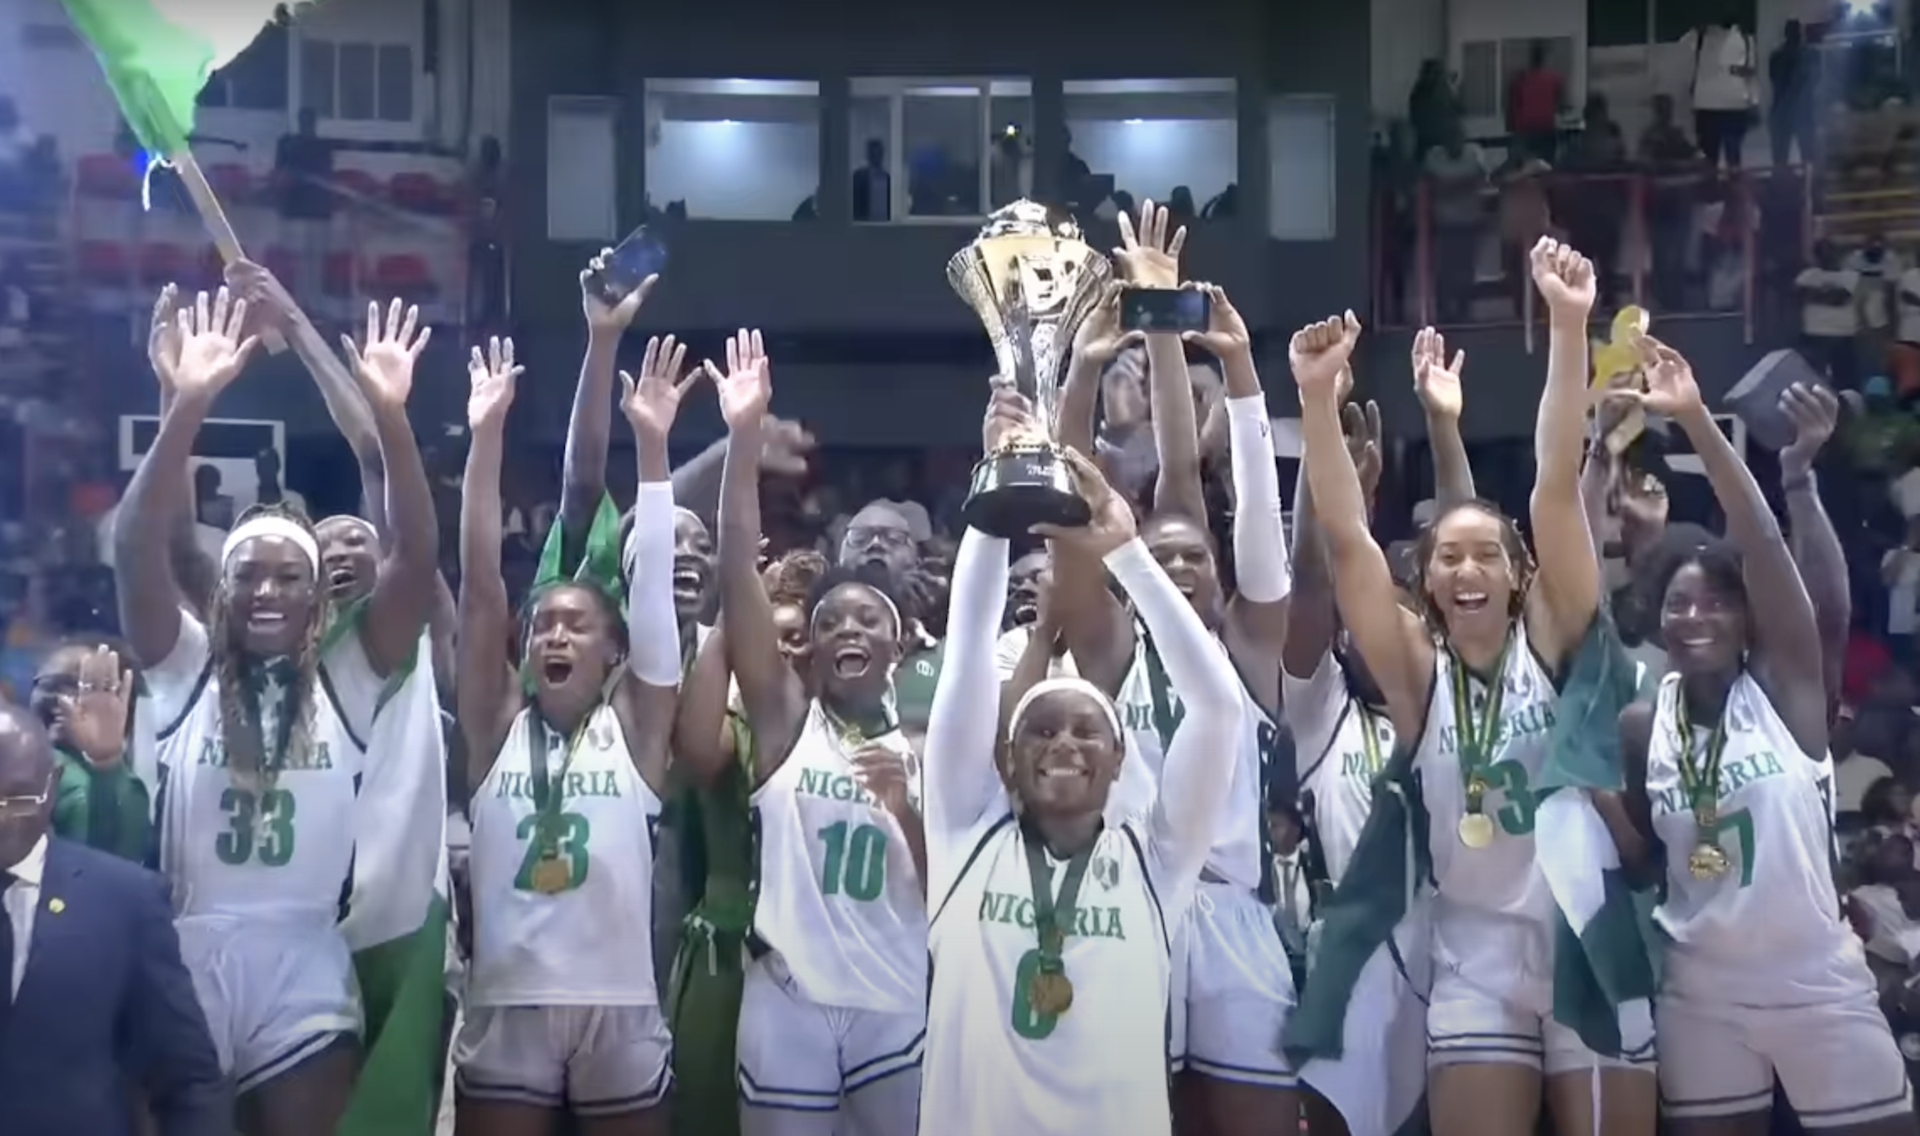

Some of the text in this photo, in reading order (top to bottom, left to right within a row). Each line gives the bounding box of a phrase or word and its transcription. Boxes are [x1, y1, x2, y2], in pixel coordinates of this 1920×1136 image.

[1659, 751, 1785, 816] NIERIA
[215, 787, 297, 867] 33
[513, 812, 590, 892] 23
[817, 820, 888, 902] 10
[1710, 807, 1755, 889] 7
[978, 891, 1126, 940] NIGRIA
